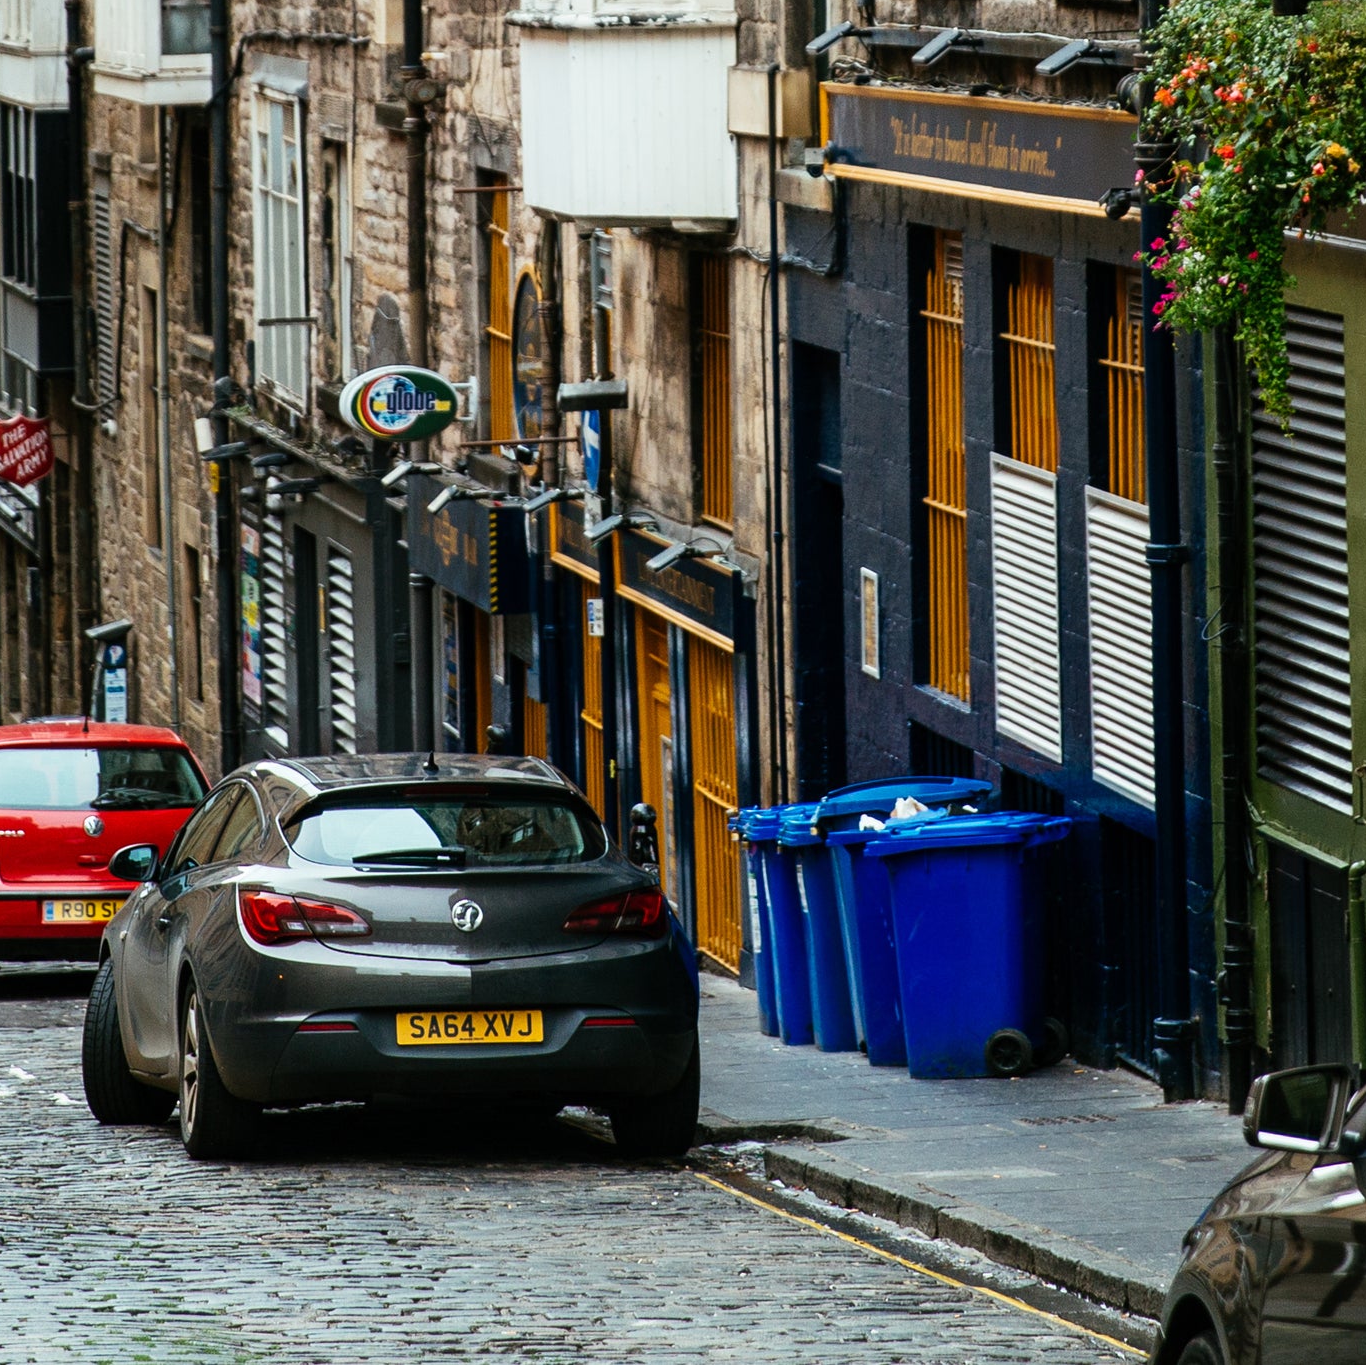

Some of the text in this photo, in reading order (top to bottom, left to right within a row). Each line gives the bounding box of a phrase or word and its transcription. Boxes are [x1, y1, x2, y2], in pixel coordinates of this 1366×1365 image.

[386, 386, 437, 415] globe
[1, 423, 28, 448] THE
[15, 443, 49, 481] ARMY
[409, 1013, 533, 1039] SA64 XVJ
